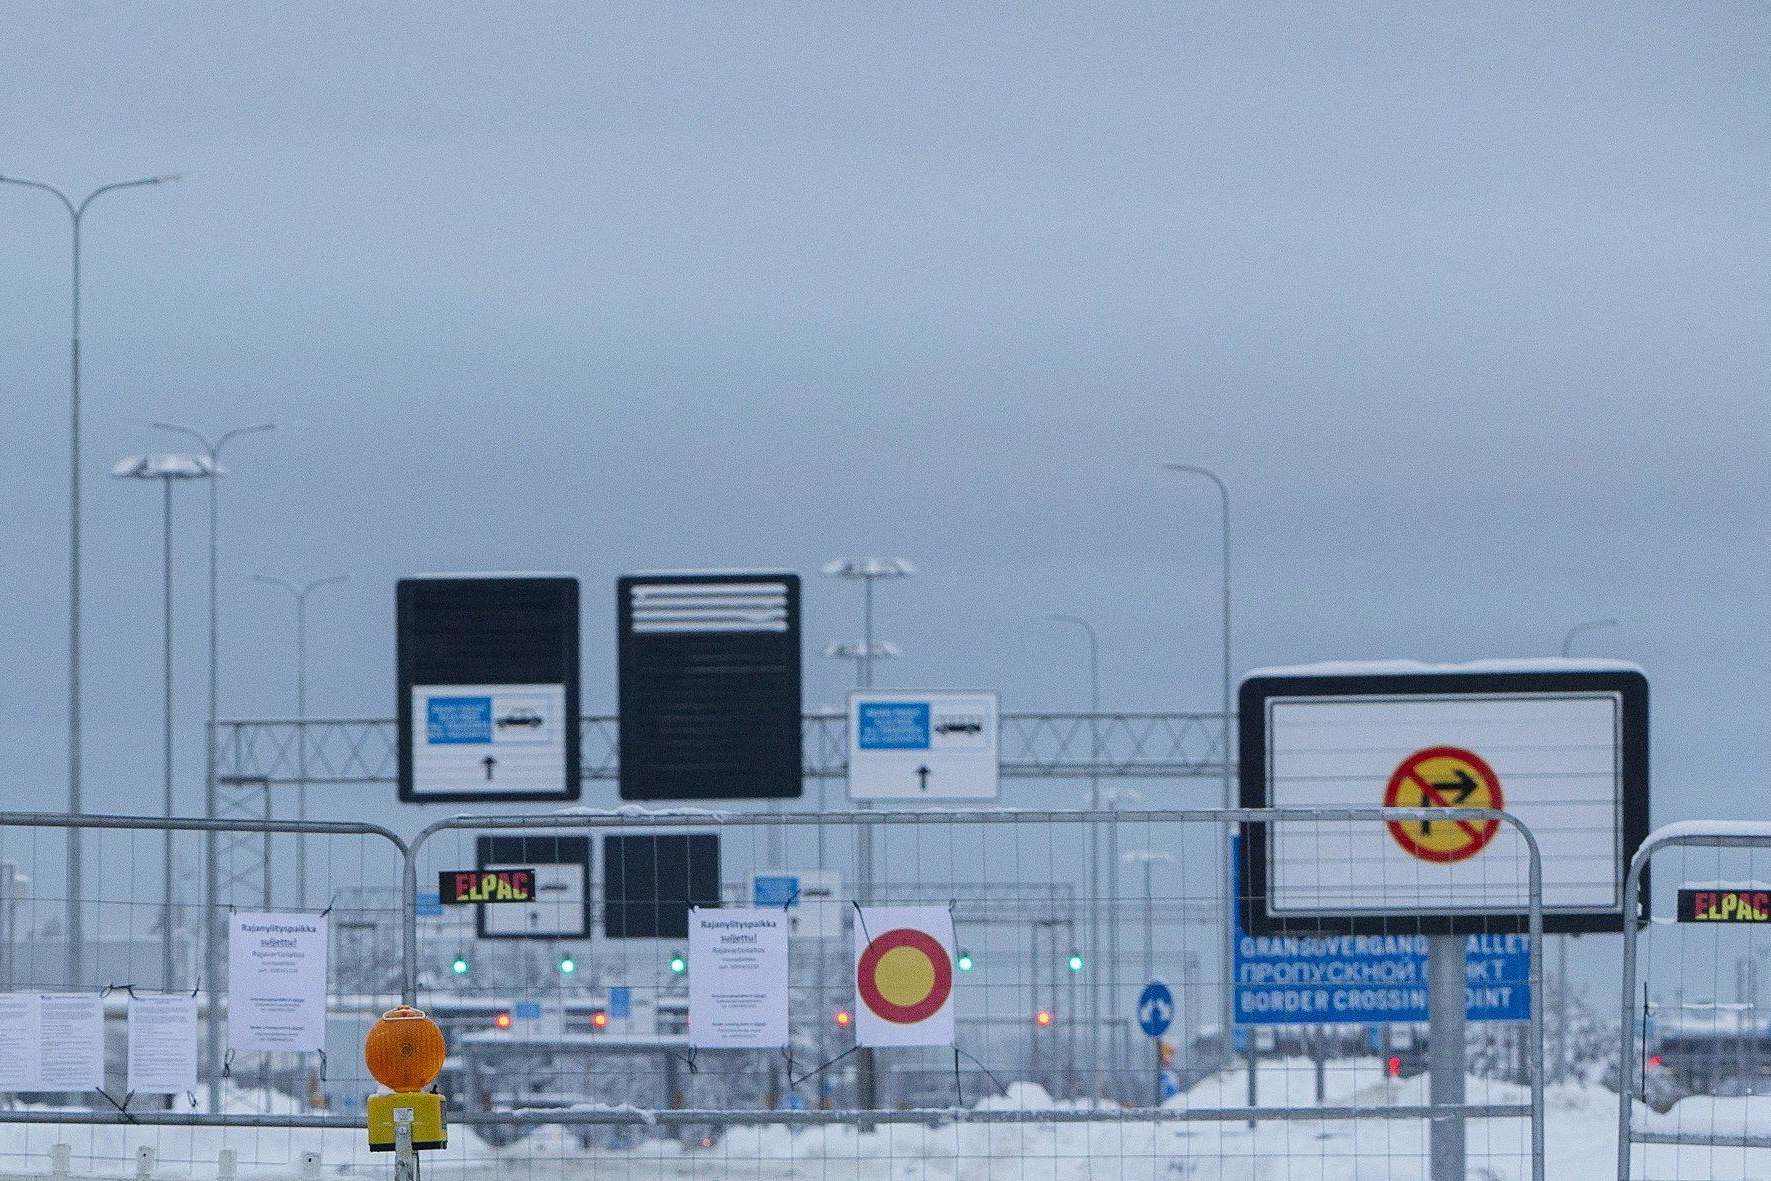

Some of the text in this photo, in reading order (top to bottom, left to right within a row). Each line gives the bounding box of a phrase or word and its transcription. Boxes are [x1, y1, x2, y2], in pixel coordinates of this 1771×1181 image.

[455, 872, 529, 901] ELPAC
[1694, 892, 1768, 921] ELPAC
[1240, 957, 1416, 984] ПРОПУСКНОЙ
[1241, 986, 1513, 1012] BORDER CROSSIN OINT
